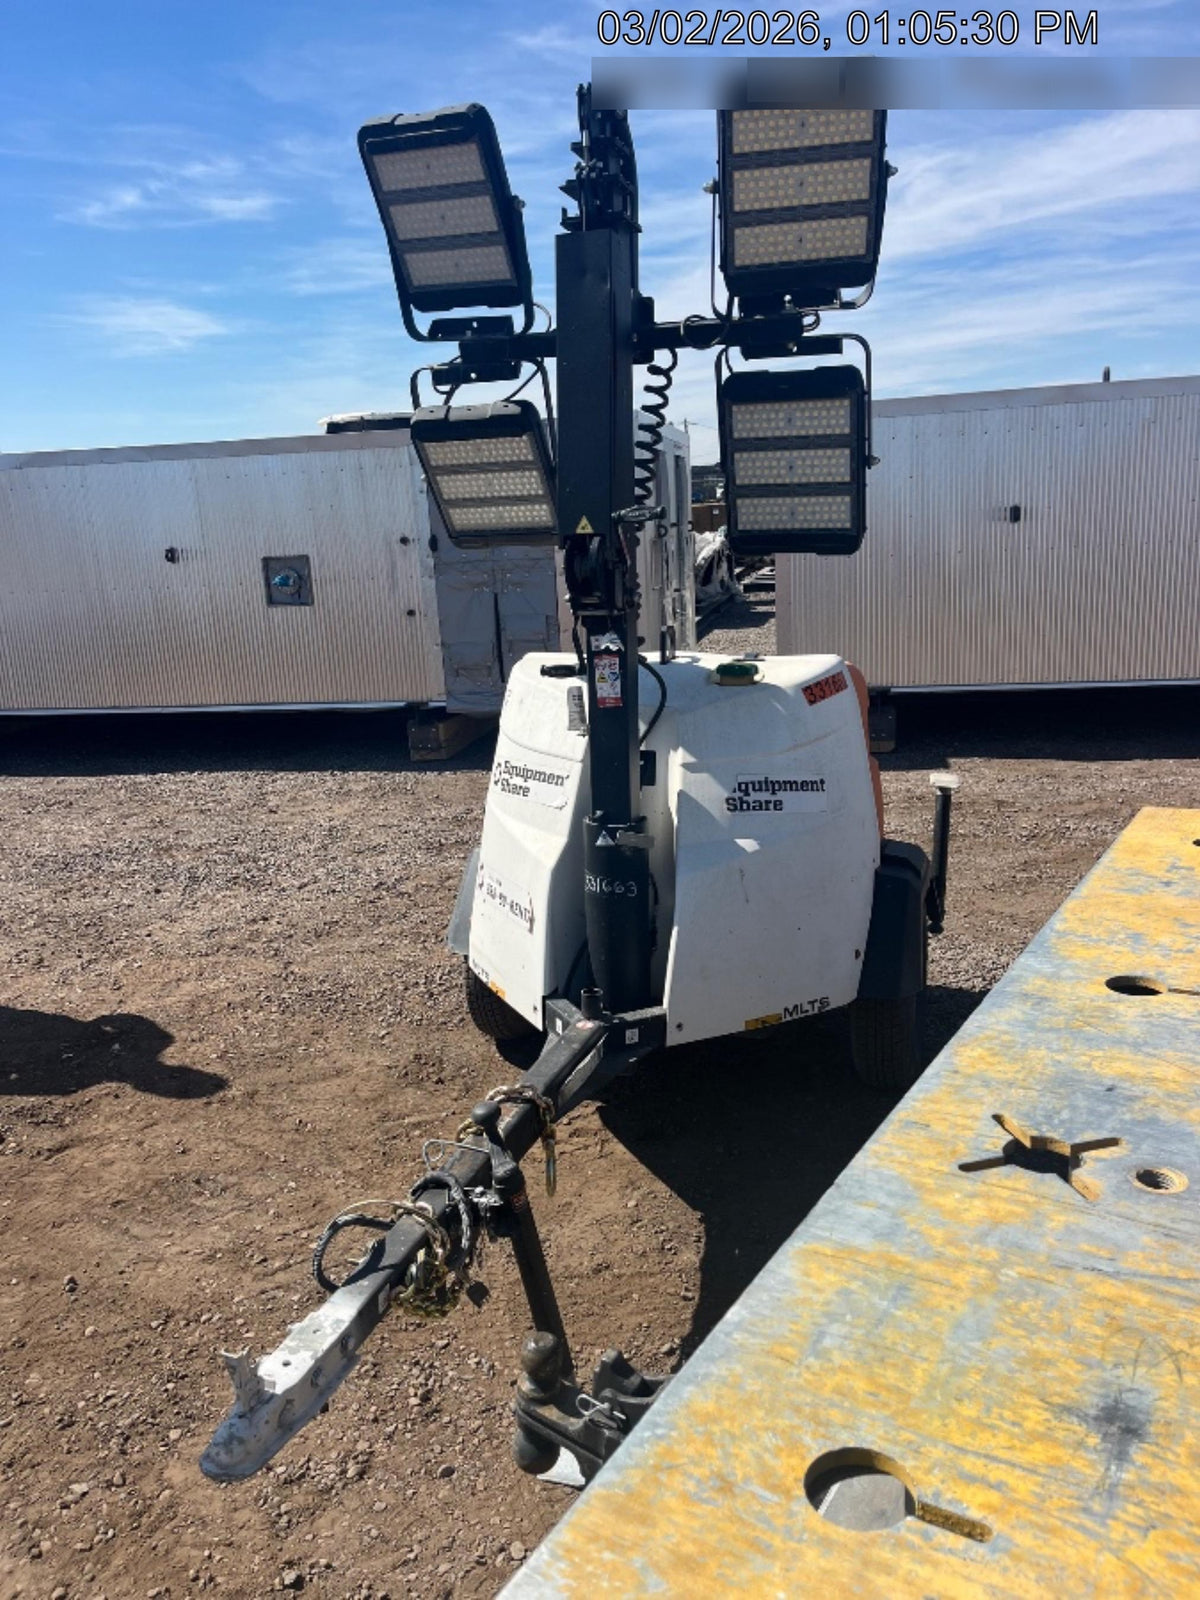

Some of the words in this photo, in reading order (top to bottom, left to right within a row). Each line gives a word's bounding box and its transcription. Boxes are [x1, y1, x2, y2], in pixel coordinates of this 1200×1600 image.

[731, 776, 826, 797] quipment
[725, 796, 784, 812] Share
[783, 996, 830, 1019] MLTS
